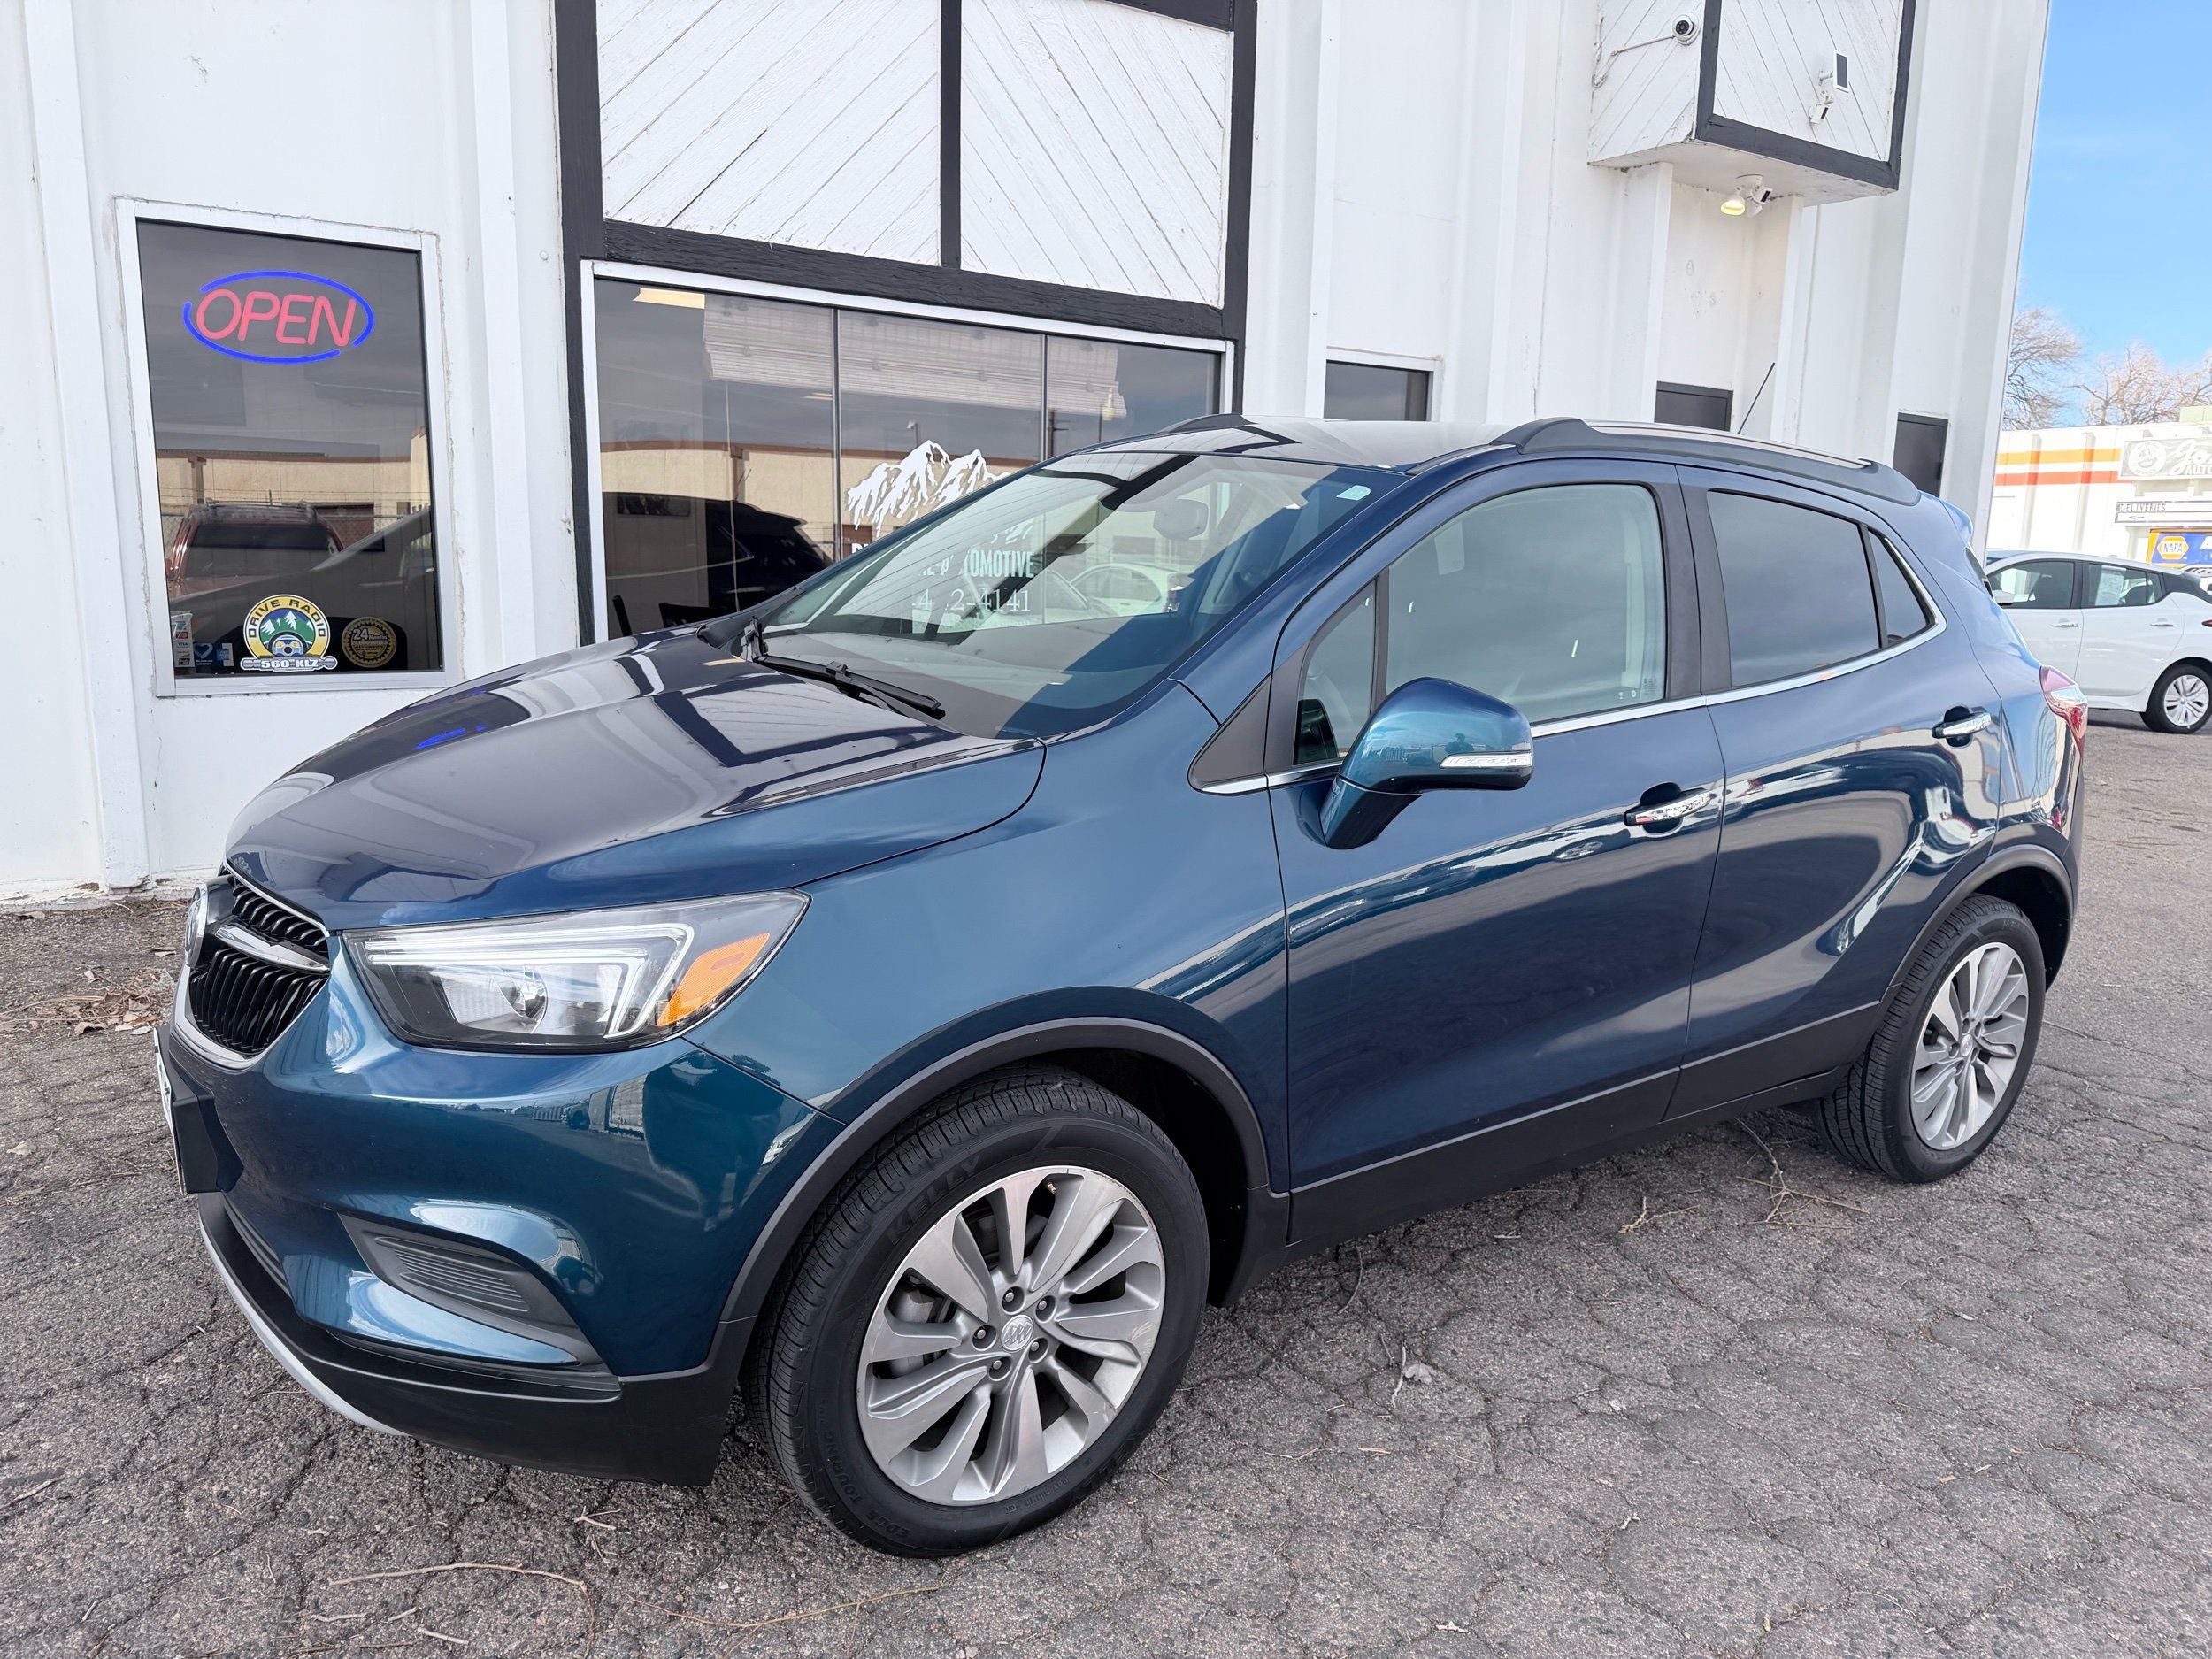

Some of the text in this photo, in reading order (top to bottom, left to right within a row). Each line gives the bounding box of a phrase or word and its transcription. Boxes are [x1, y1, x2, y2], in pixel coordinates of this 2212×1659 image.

[196, 288, 357, 347] OPEN
[2121, 503, 2166, 512] DELIVERIES
[2163, 542, 2183, 553] NAPA
[248, 599, 326, 638] DRIVE RADIO
[353, 628, 369, 641] 24
[261, 659, 319, 668] 560-KLZ
[888, 1154, 980, 1245] KELLY
[823, 1430, 913, 1540] EDGE TOURING
